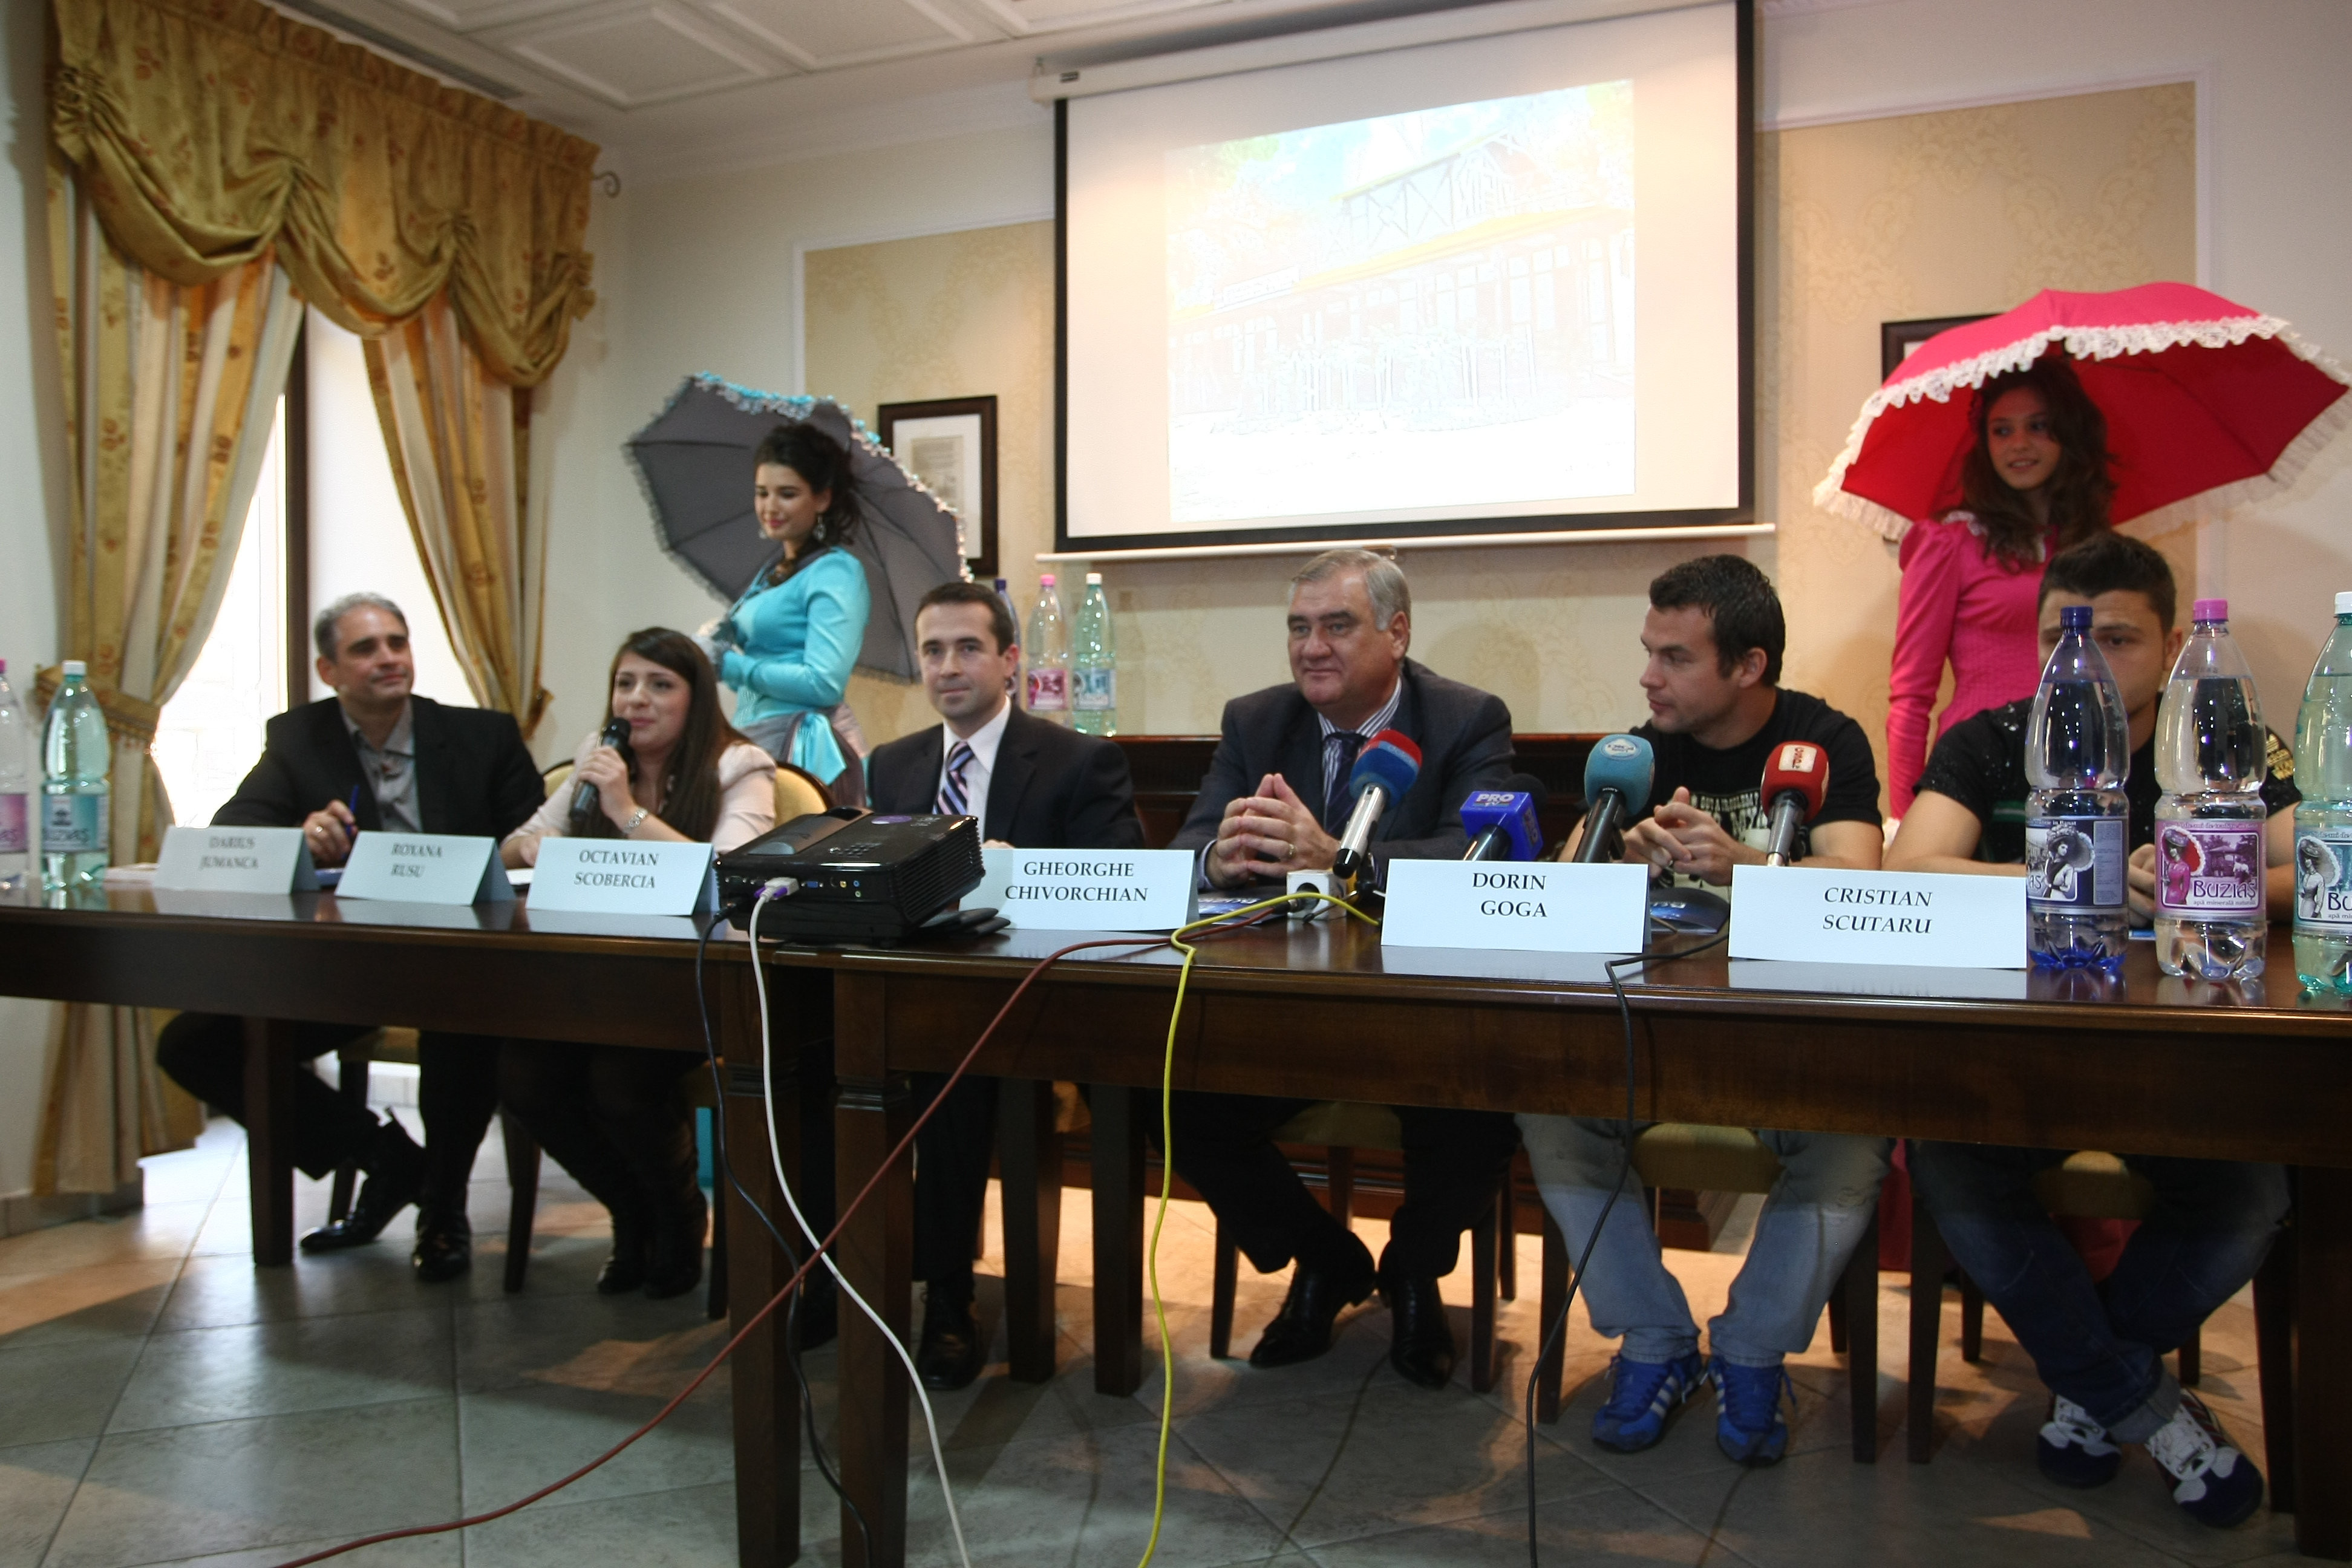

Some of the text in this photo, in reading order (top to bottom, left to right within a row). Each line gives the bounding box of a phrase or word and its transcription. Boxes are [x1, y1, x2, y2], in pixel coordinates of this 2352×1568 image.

[1476, 794, 1515, 802] PRO
[579, 850, 659, 866] OCTAVIAN
[1024, 861, 1134, 877] GHEORGHE
[573, 872, 655, 888] SCOBERCIA
[1472, 872, 1547, 890] DORIN
[1005, 886, 1148, 901] CHIVORCHIAN
[1824, 887, 1933, 907] CRISTIAN
[1480, 900, 1547, 918] GOGA
[1822, 914, 1933, 934] SCUTARU
